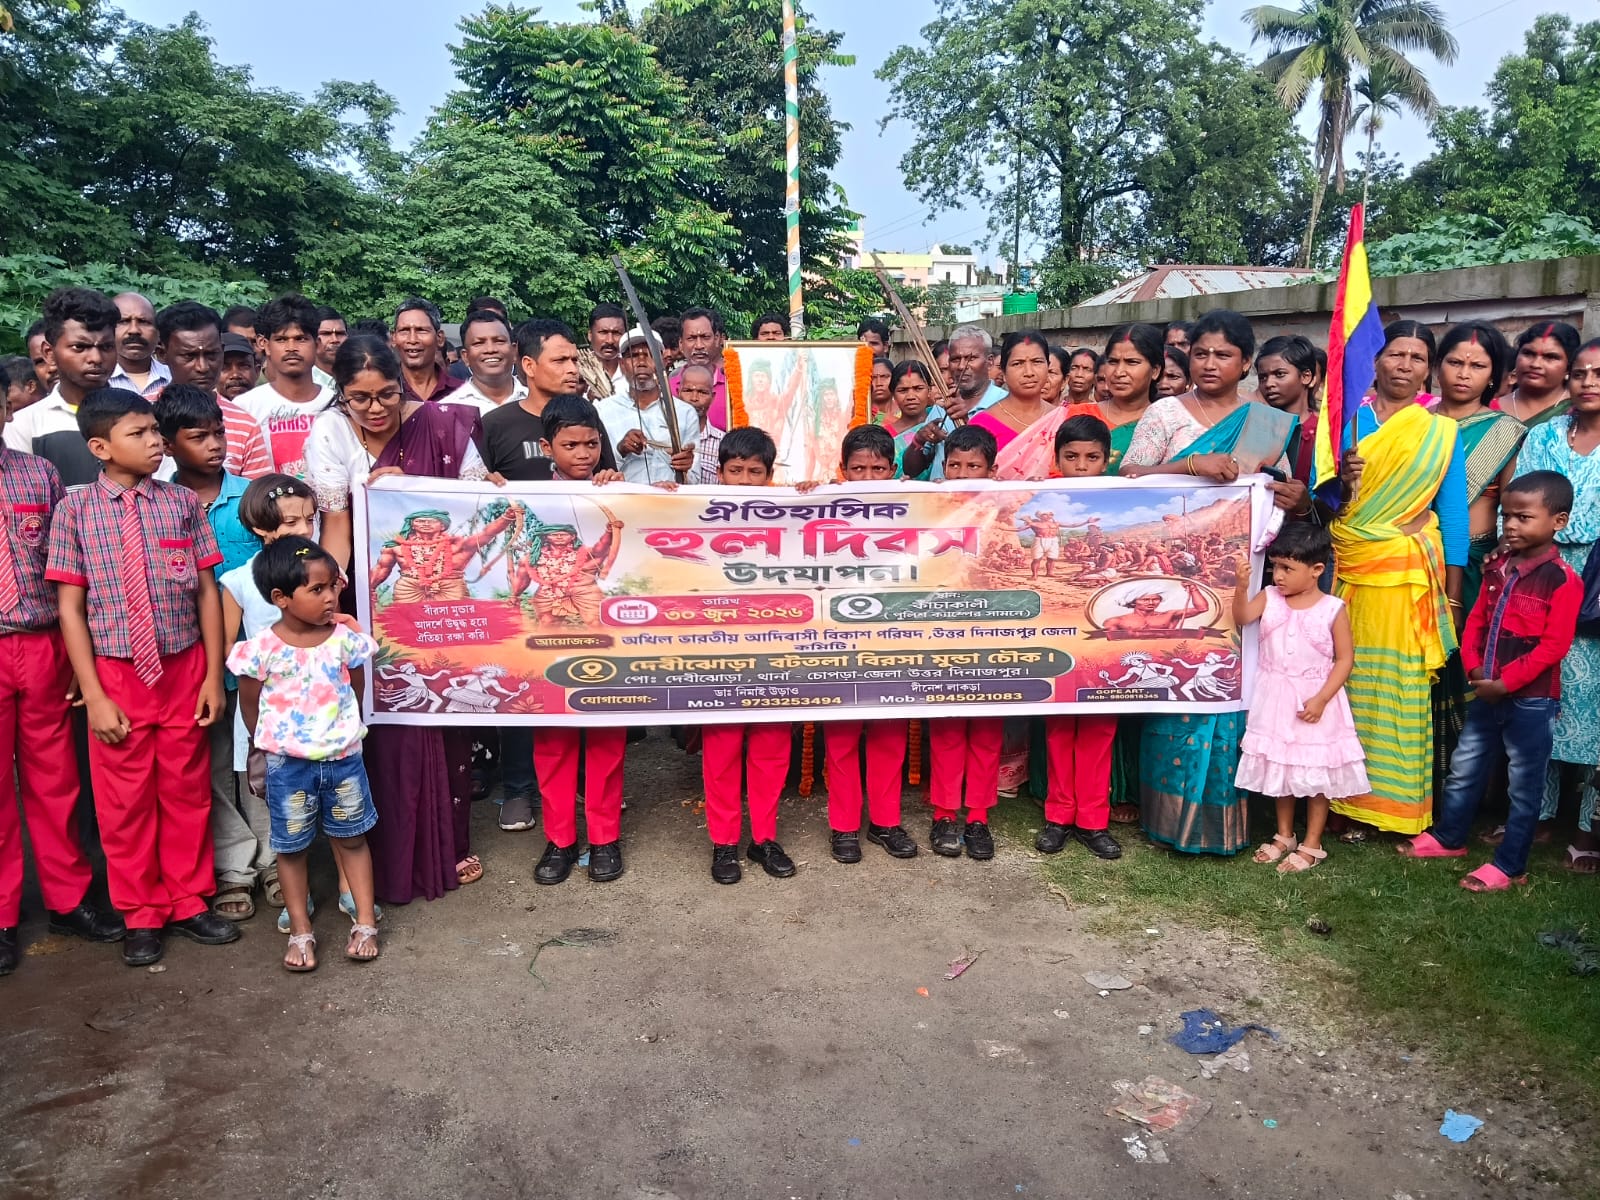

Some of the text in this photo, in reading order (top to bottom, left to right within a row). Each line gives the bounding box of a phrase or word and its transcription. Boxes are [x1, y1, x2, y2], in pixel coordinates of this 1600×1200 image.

[699, 498, 909, 522] ঐতিহাসিক
[799, 518, 979, 561] দিবস
[664, 607, 803, 622] ৩০ জুন ২০২৬
[621, 632, 673, 645] অখিল
[678, 630, 739, 644] ভারতীয়
[744, 629, 818, 642] আদিবাসী
[823, 628, 871, 640] বিকাশ
[876, 627, 923, 639] পরিষদ
[971, 626, 1037, 639] দিনাজপুর
[1041, 626, 1077, 636] জেলা
[629, 656, 757, 672] দেবীঝোড়া
[768, 654, 849, 668] বটতলা
[856, 652, 924, 666] বিরসা
[907, 667, 942, 678] উত্তর
[910, 682, 981, 693] দীনেশ লাকড়া
[687, 700, 725, 708] Mob
[741, 696, 842, 706] 9733253494
[880, 695, 915, 703] Mob
